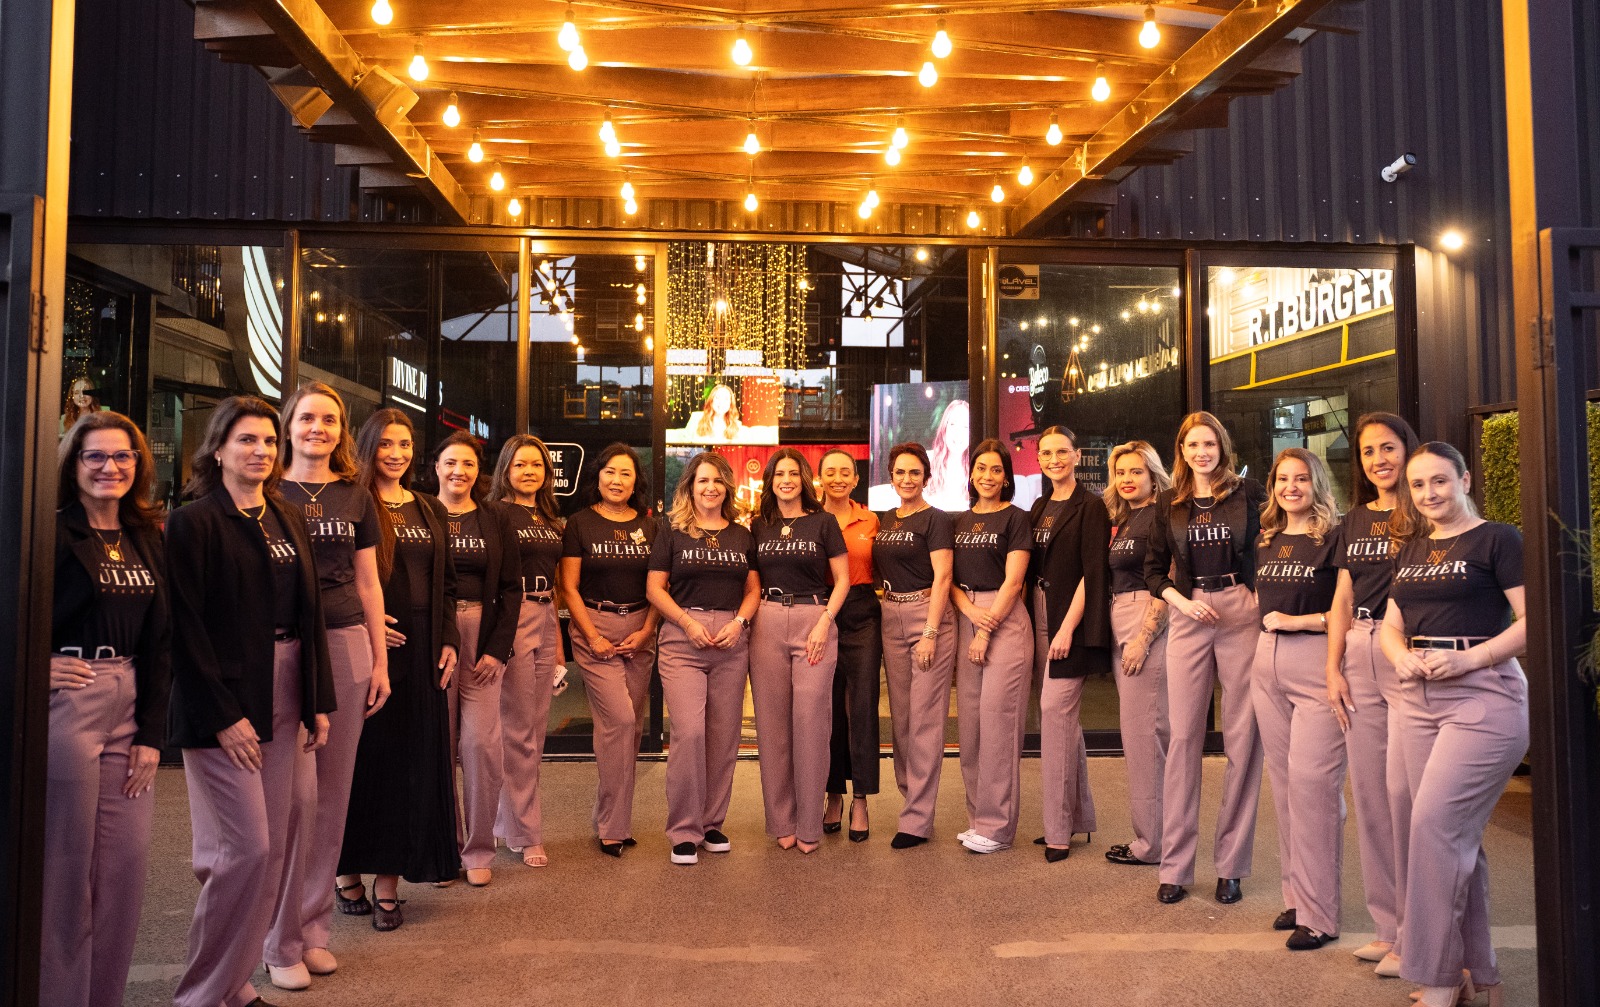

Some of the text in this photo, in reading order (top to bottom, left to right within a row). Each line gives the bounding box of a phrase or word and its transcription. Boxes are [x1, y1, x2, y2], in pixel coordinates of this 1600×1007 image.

[393, 356, 418, 396] DIVINE
[394, 527, 431, 539] LHE
[955, 533, 998, 544] ULHER
[681, 549, 748, 564] MULHER
